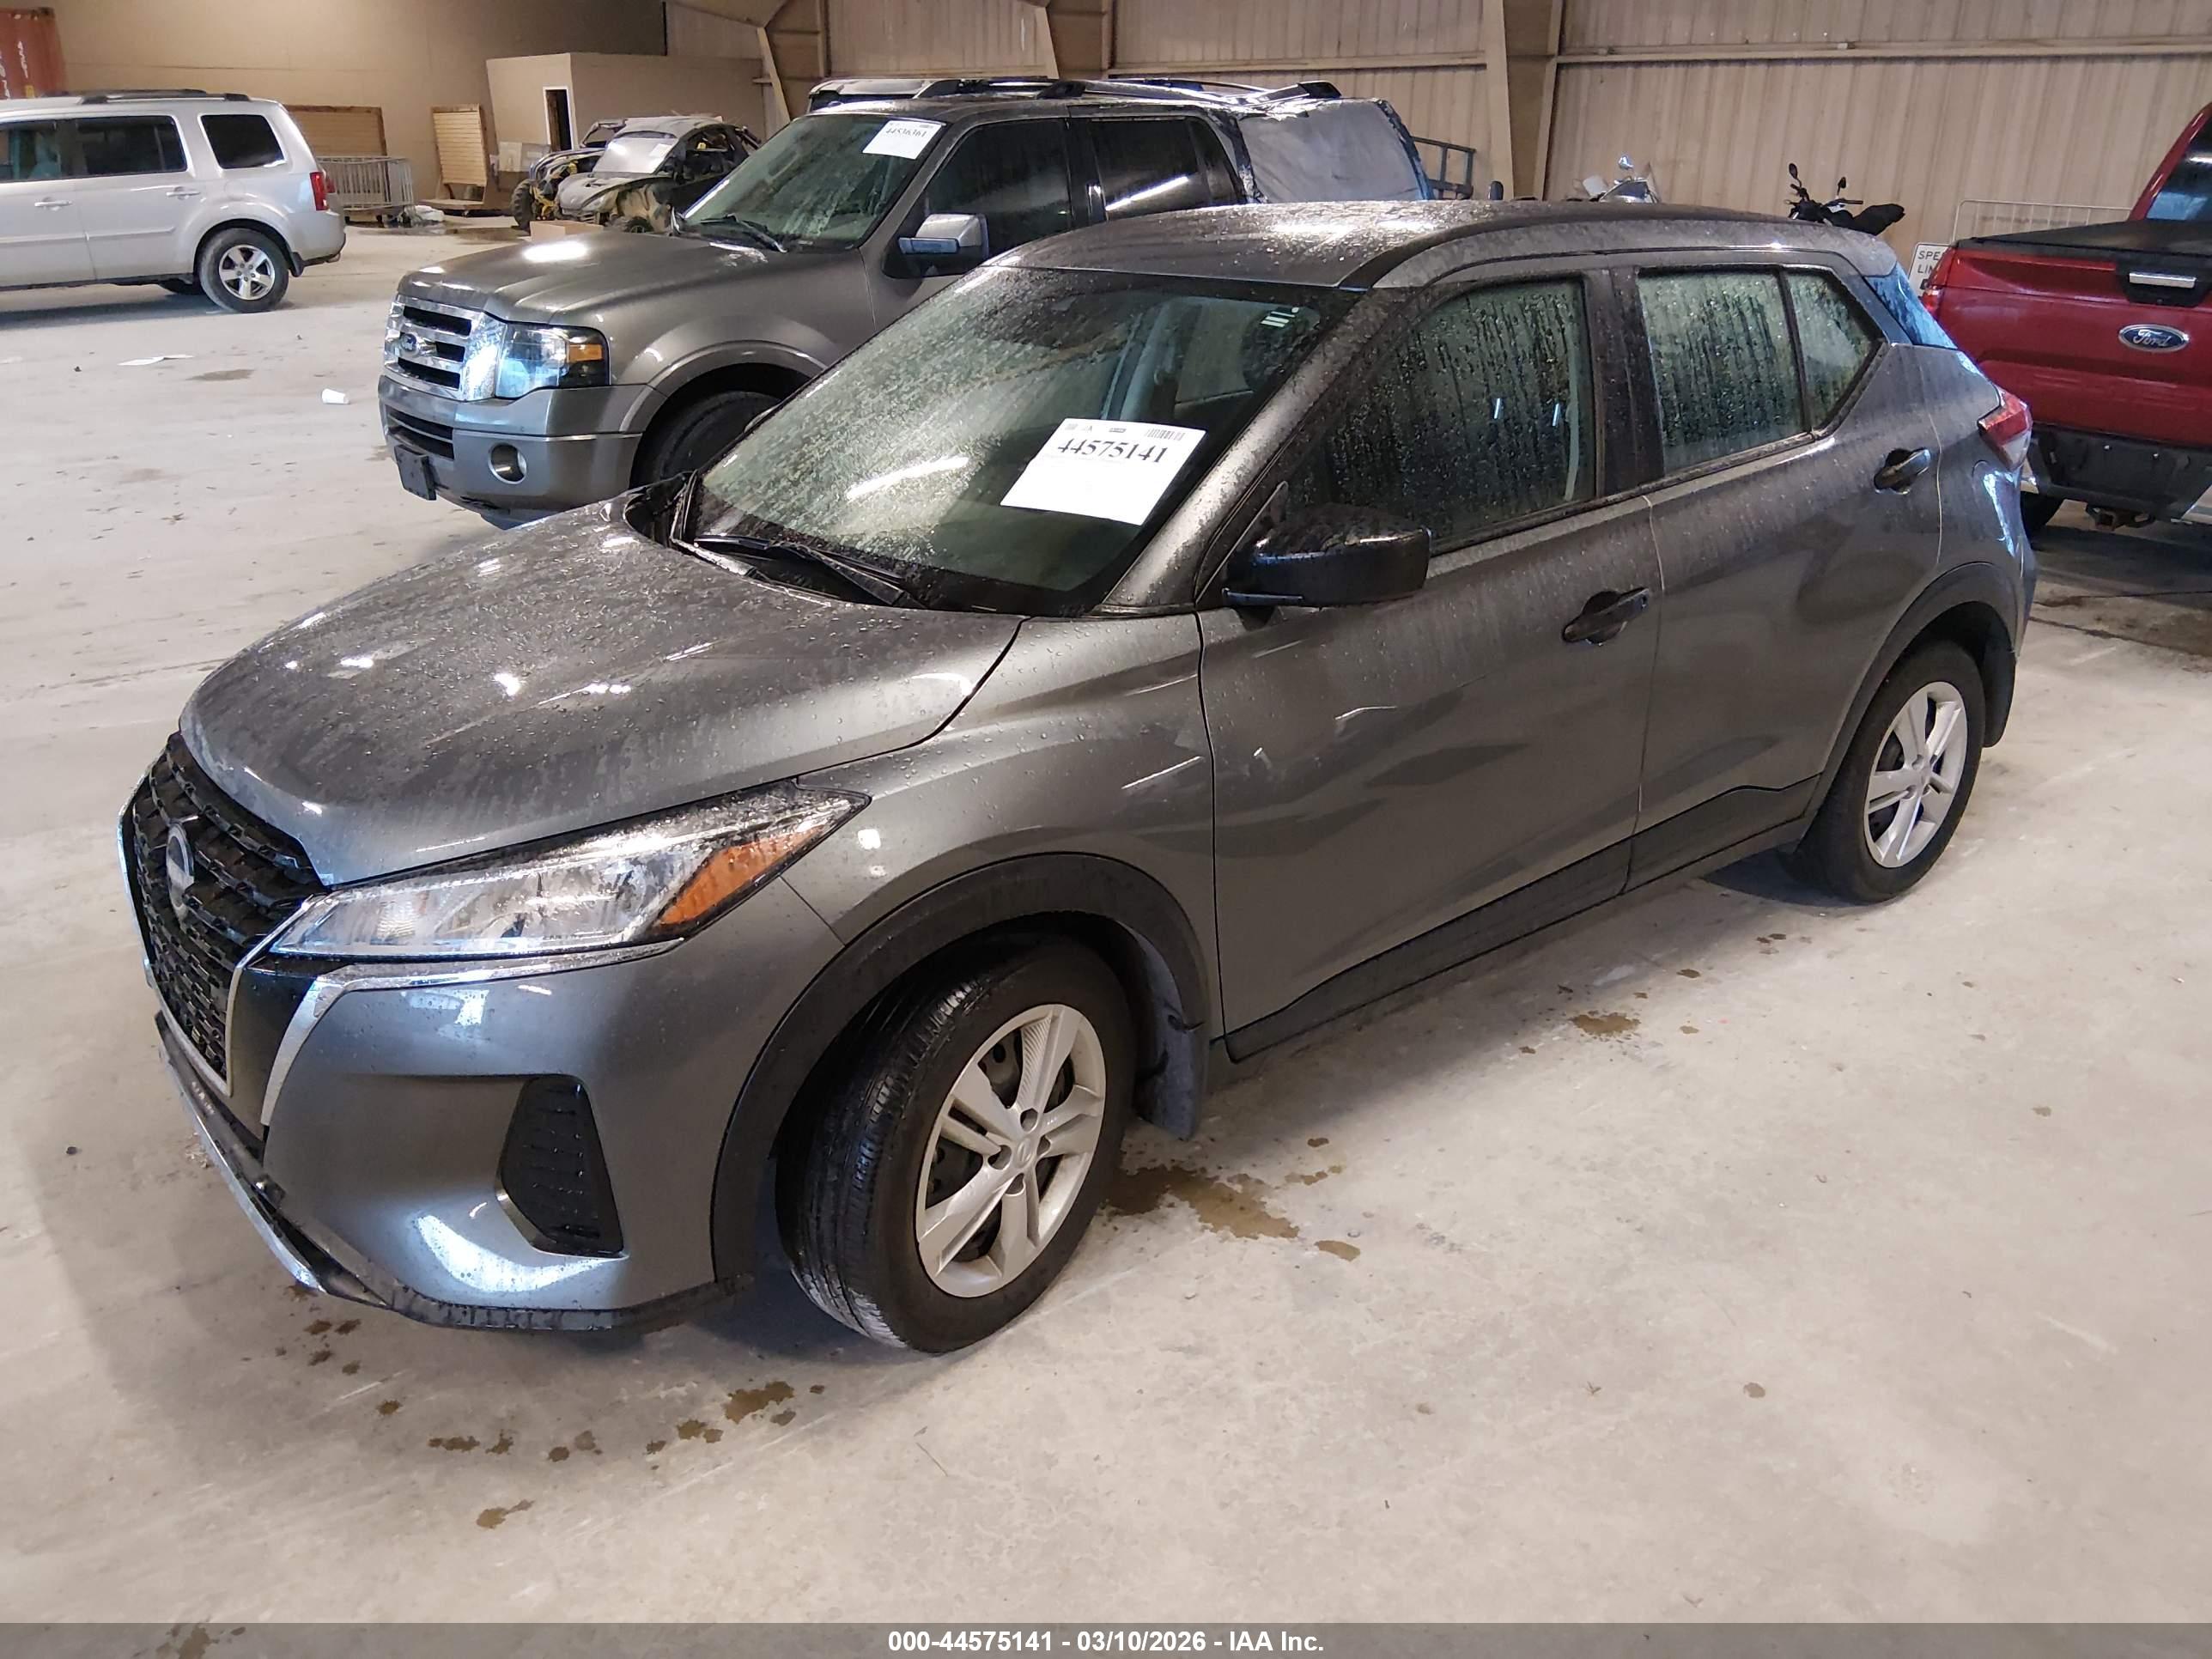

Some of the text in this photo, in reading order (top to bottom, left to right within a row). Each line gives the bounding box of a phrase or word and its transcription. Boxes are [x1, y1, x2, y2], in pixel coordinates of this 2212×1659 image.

[1917, 250, 1941, 261] SPE
[2132, 329, 2172, 347] Ford
[1057, 437, 1169, 463] 44575141
